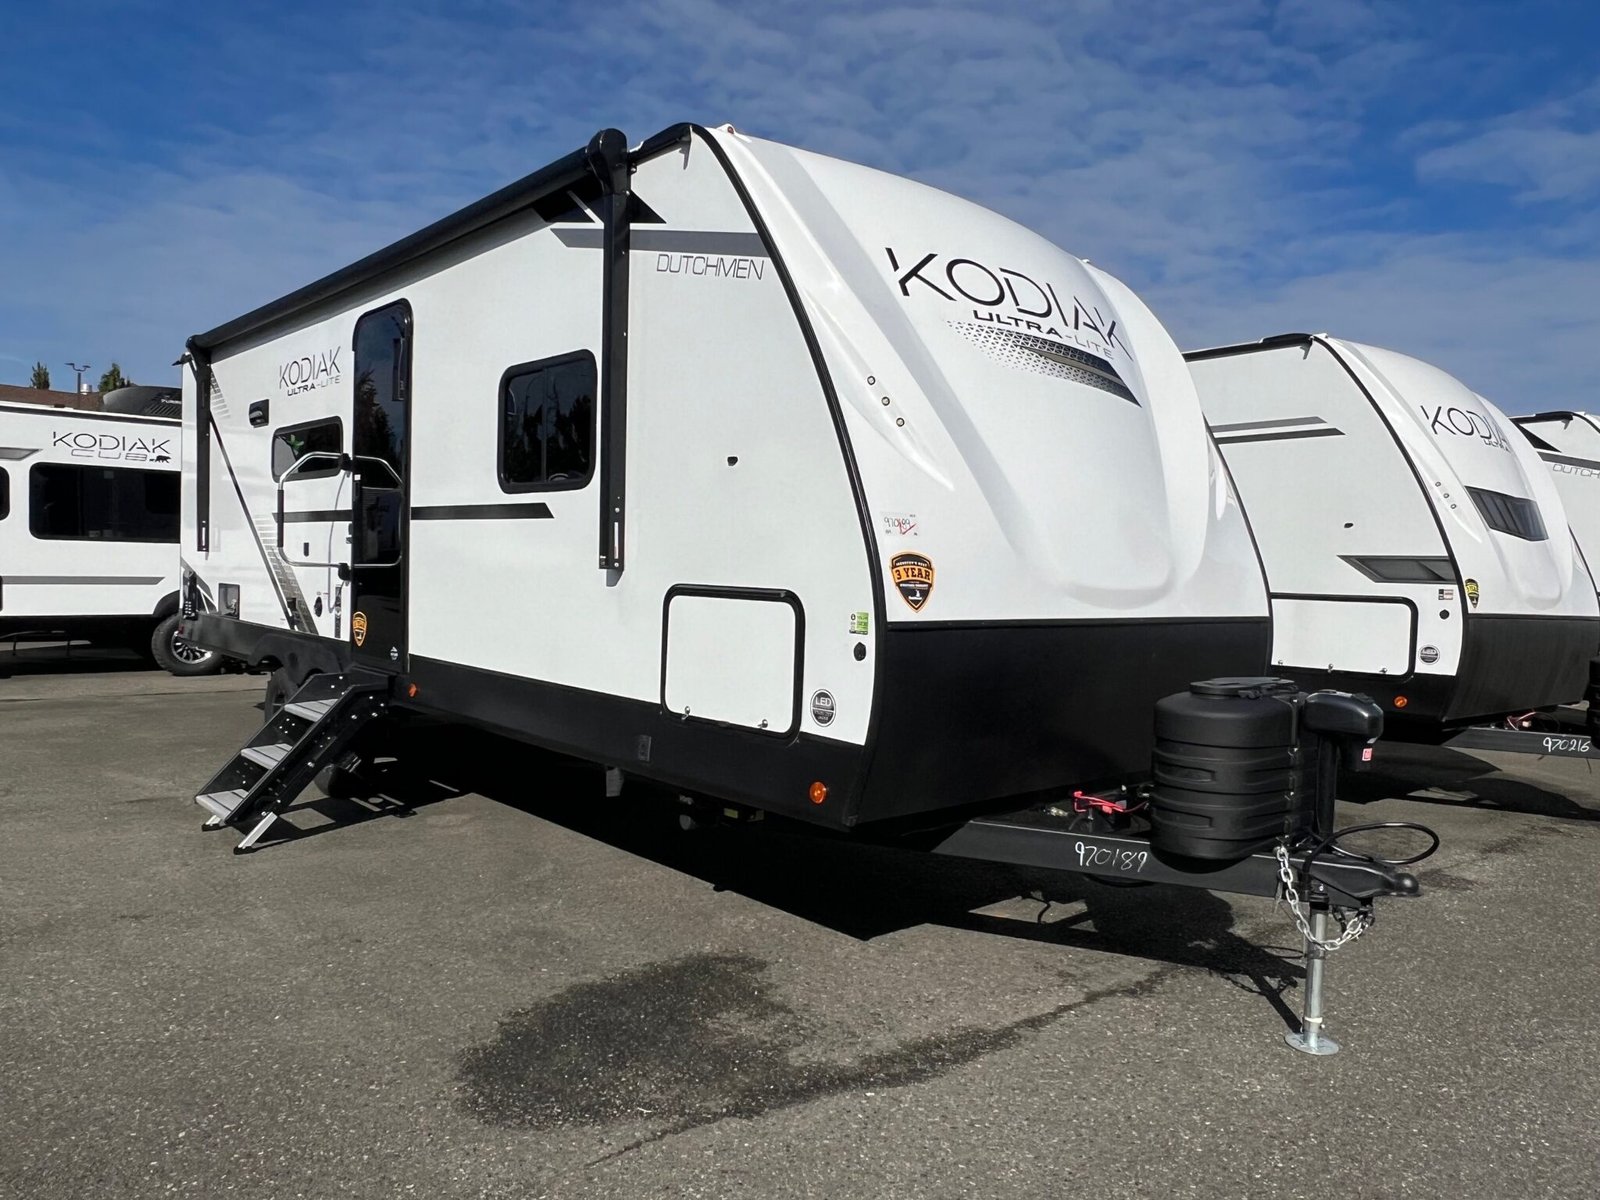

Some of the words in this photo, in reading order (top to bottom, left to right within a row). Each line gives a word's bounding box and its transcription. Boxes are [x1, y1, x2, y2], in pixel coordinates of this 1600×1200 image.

[656, 253, 765, 280] DUTCHMEN
[884, 247, 1134, 361] KODIAK
[972, 309, 1114, 360] ULTRA-LITE
[279, 345, 341, 390] KODIAK
[287, 374, 341, 397] ULTRA-LITE
[53, 431, 171, 455] KODIAK
[71, 448, 148, 462] CUB
[895, 569, 902, 580] 3
[903, 567, 931, 581] YEAR
[815, 696, 832, 707] LED
[1542, 737, 1592, 753] 970216
[1074, 841, 1148, 873] 970189
